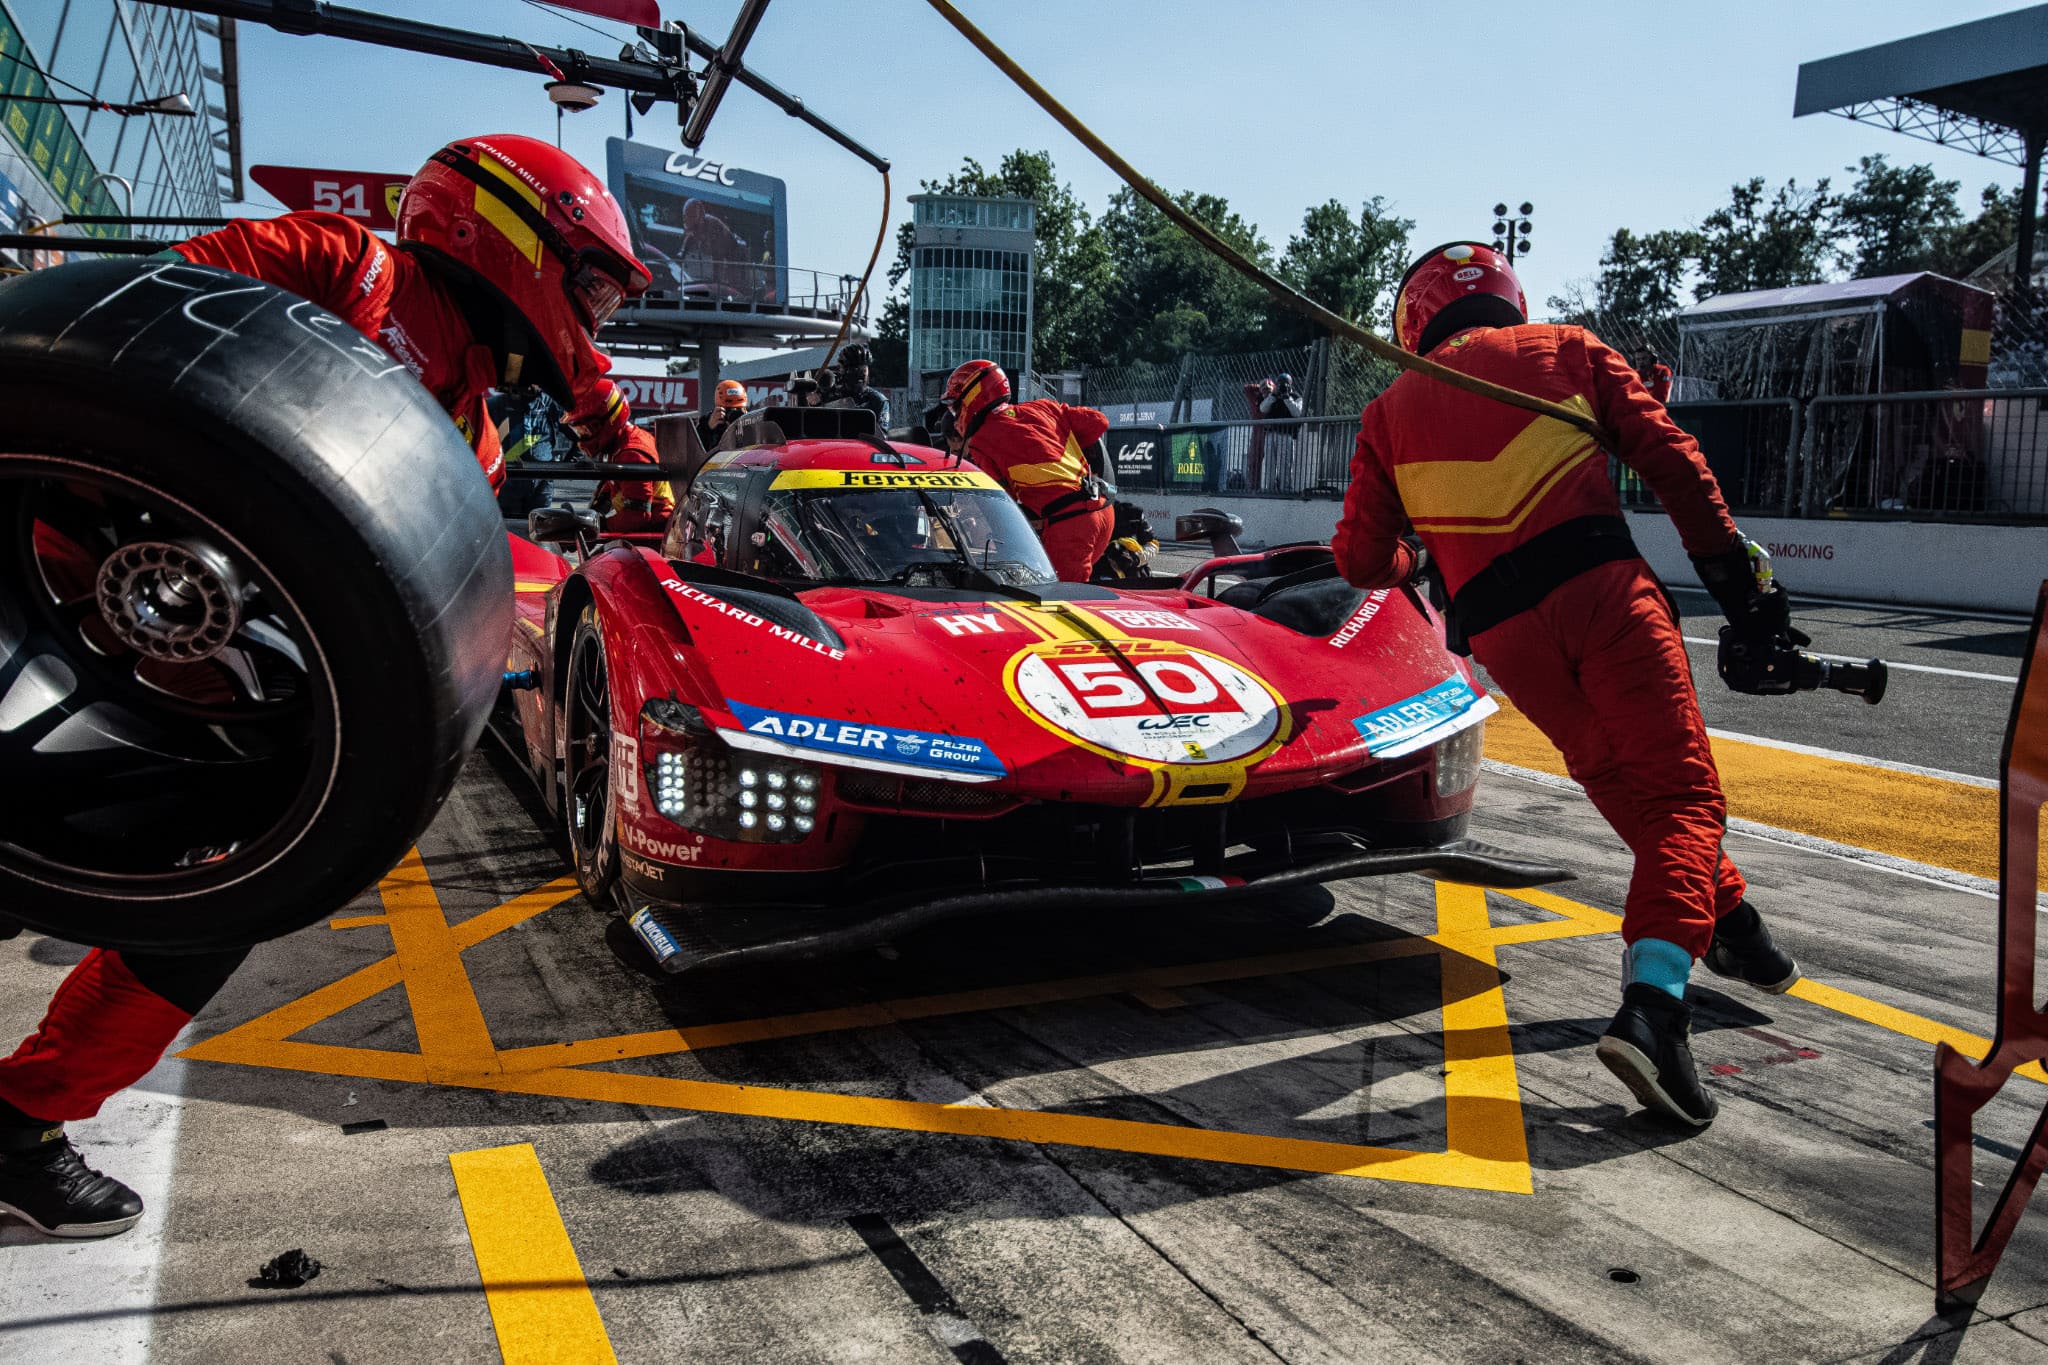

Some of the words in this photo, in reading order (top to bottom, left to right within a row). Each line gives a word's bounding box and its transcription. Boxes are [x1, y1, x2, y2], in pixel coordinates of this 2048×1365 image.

[473, 141, 517, 168] RICHARD
[516, 167, 548, 194] MILLE
[665, 152, 735, 186] WEC
[313, 180, 371, 217] 51
[1457, 270, 1480, 279] BELL
[617, 379, 688, 406] OTUL
[1118, 441, 1155, 461] WEC
[839, 471, 980, 488] Ferrari
[1177, 463, 1206, 475] ROLEX
[1767, 543, 1834, 560] SMOKING
[660, 578, 764, 627] RICHARD
[768, 625, 846, 661] MILLE
[933, 613, 1006, 636] HY
[1328, 601, 1381, 648] RICHARD
[1053, 642, 1166, 655] DHL
[1057, 660, 1220, 708] 50
[1137, 714, 1210, 730] WEC
[1364, 701, 1438, 736] ADLER
[749, 716, 888, 750] ADLER
[931, 739, 983, 753] PELZER
[929, 749, 980, 763] GROUP
[624, 822, 702, 862] V-Power
[642, 919, 676, 957] MICHELIN
